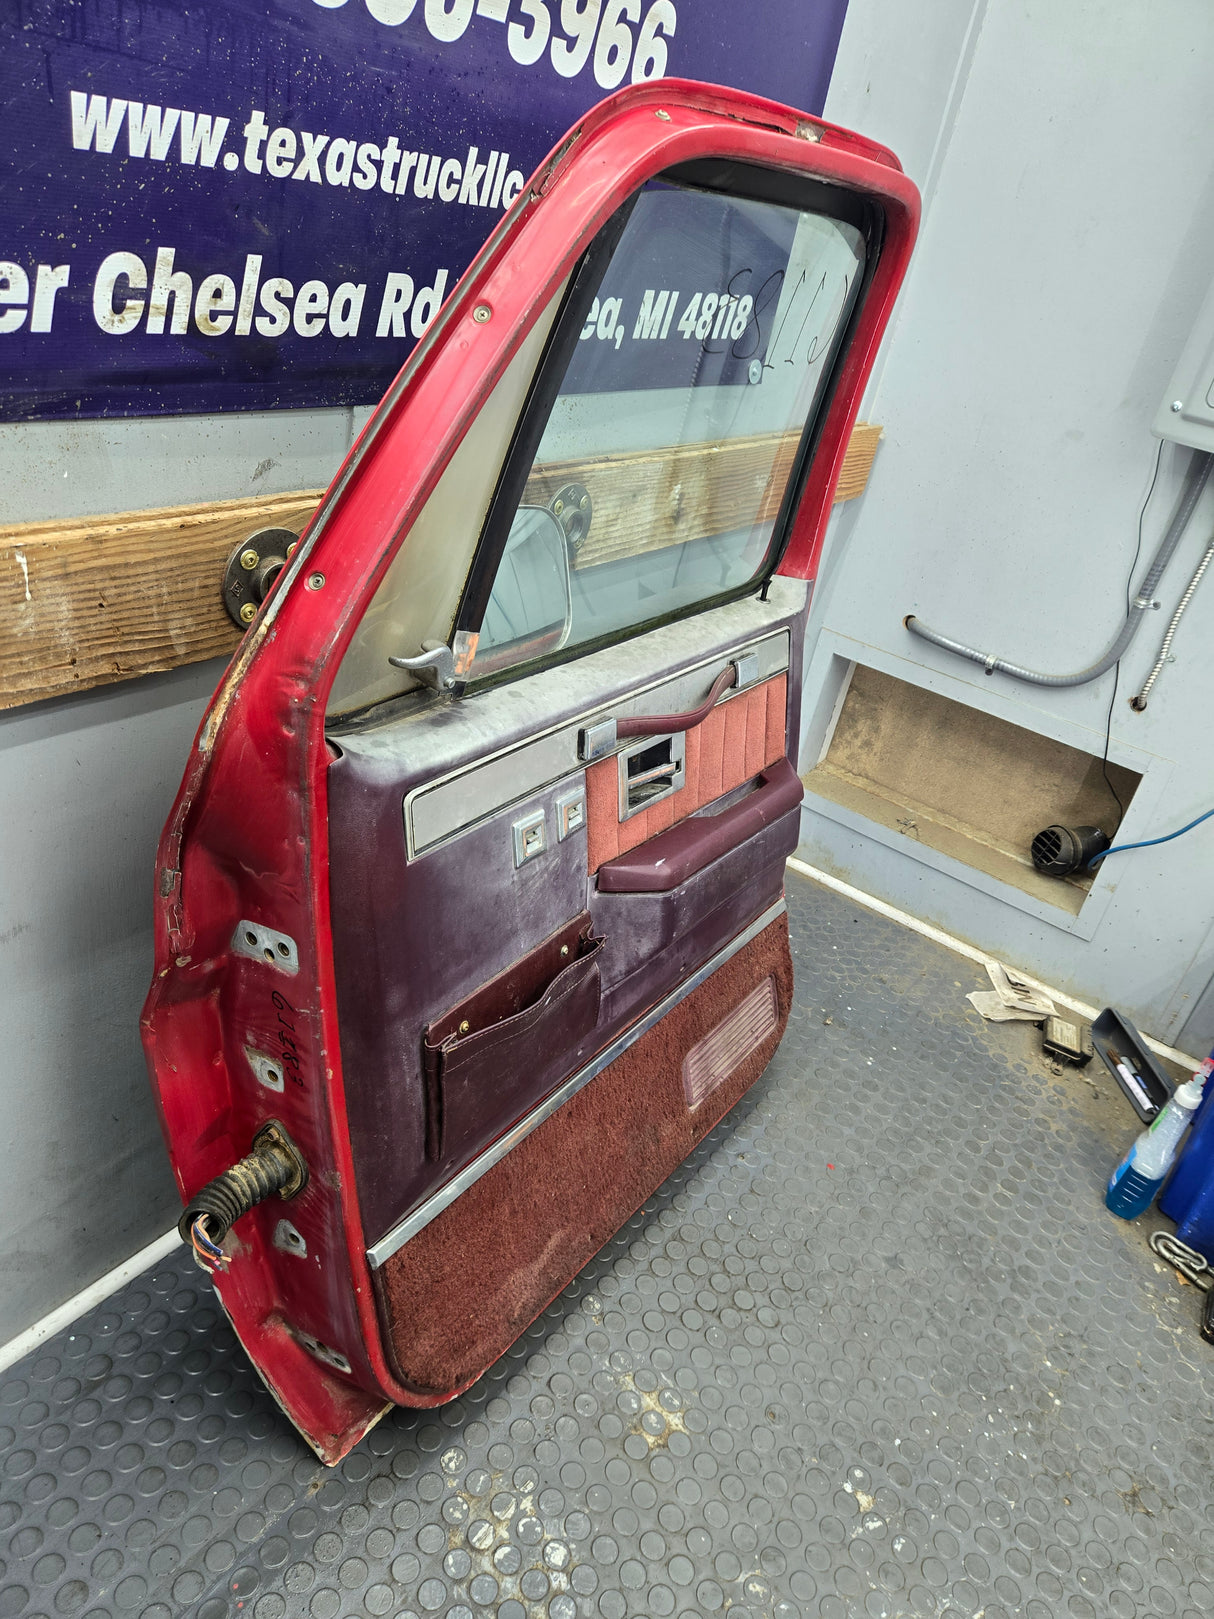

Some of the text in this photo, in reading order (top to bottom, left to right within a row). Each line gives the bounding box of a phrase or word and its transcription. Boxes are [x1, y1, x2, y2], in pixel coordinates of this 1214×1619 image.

[71, 91, 524, 211] www.texastruckllc
[93, 247, 367, 337] Chelsea
[633, 290, 679, 339] MI
[678, 292, 753, 339] 48118
